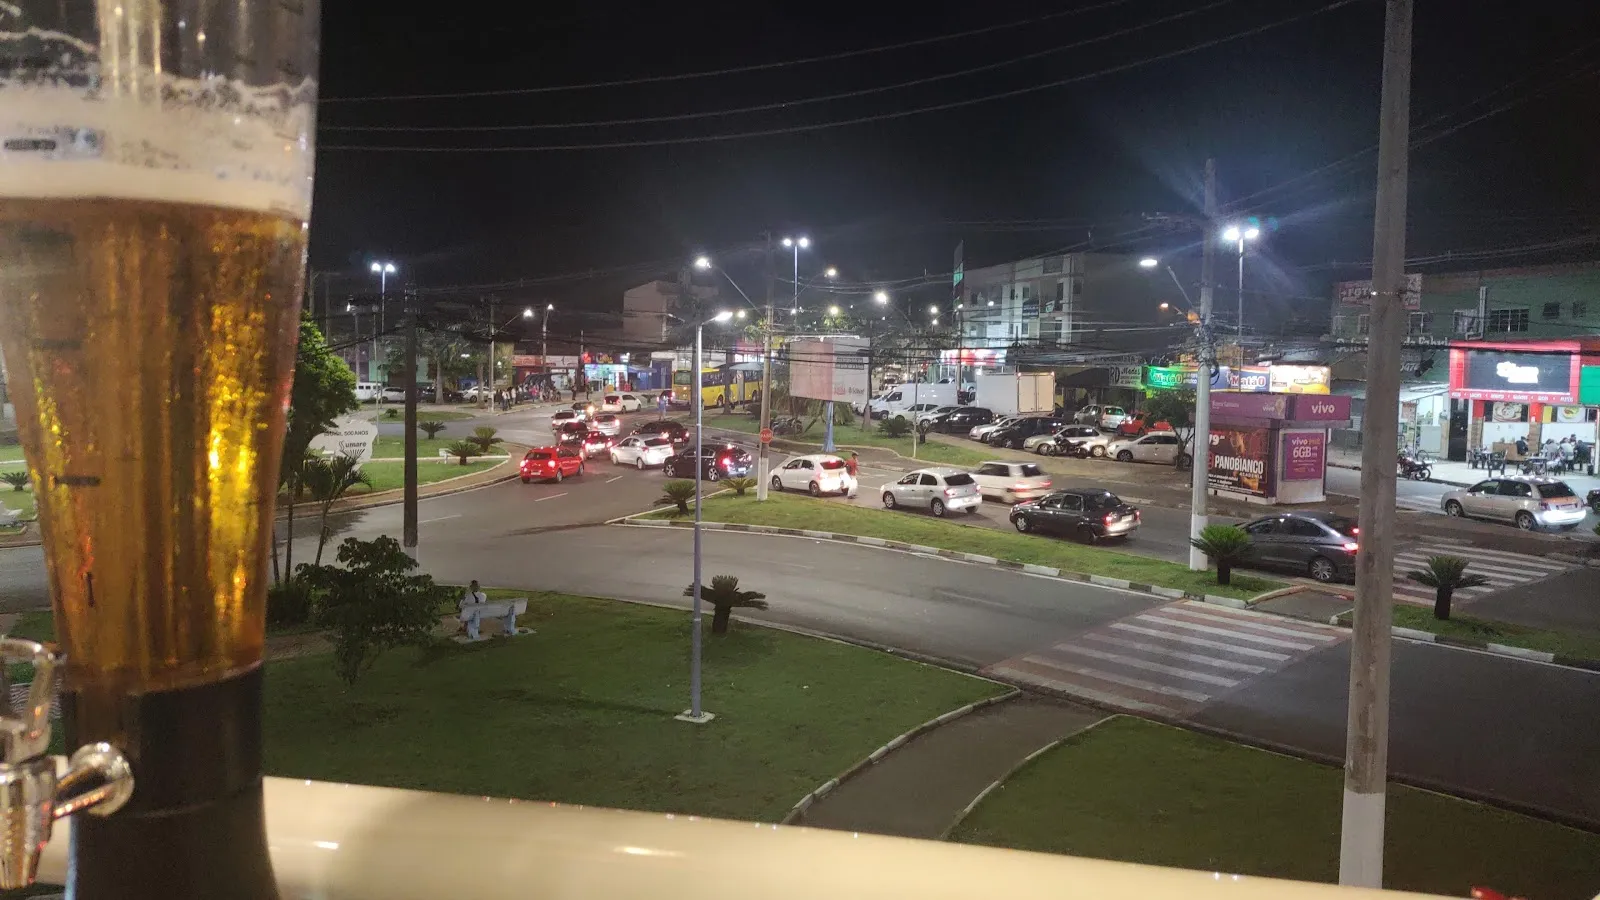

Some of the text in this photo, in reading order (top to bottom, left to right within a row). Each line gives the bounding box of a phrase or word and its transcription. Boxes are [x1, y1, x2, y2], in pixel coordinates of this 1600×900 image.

[1311, 402, 1335, 414] vivo
[1291, 437, 1308, 446] vivo
[1292, 446, 1311, 459] 6GB
[1214, 455, 1264, 475] PANOBIANCO
